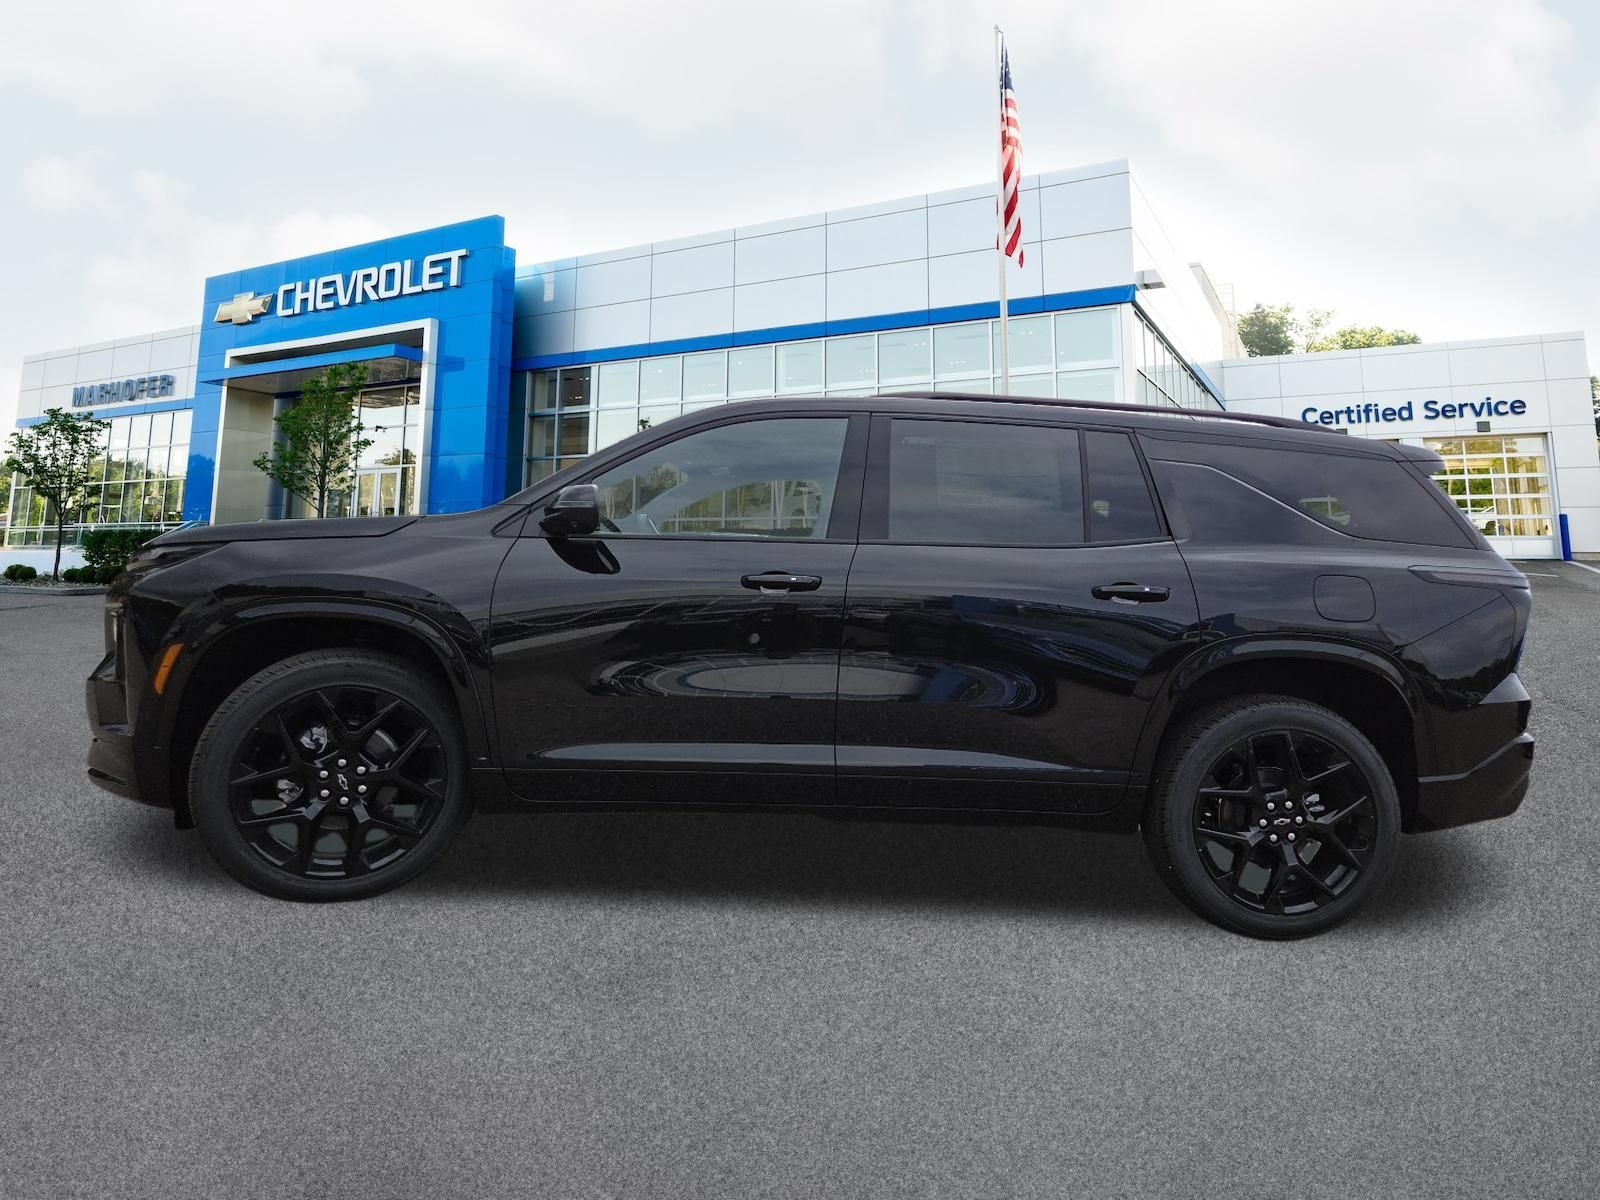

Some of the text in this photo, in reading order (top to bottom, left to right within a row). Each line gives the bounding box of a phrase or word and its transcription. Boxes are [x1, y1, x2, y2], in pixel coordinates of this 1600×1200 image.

[276, 248, 470, 317] CHEVROLET
[72, 375, 175, 407] MARHOFER
[1301, 397, 1527, 425] Certified Service
